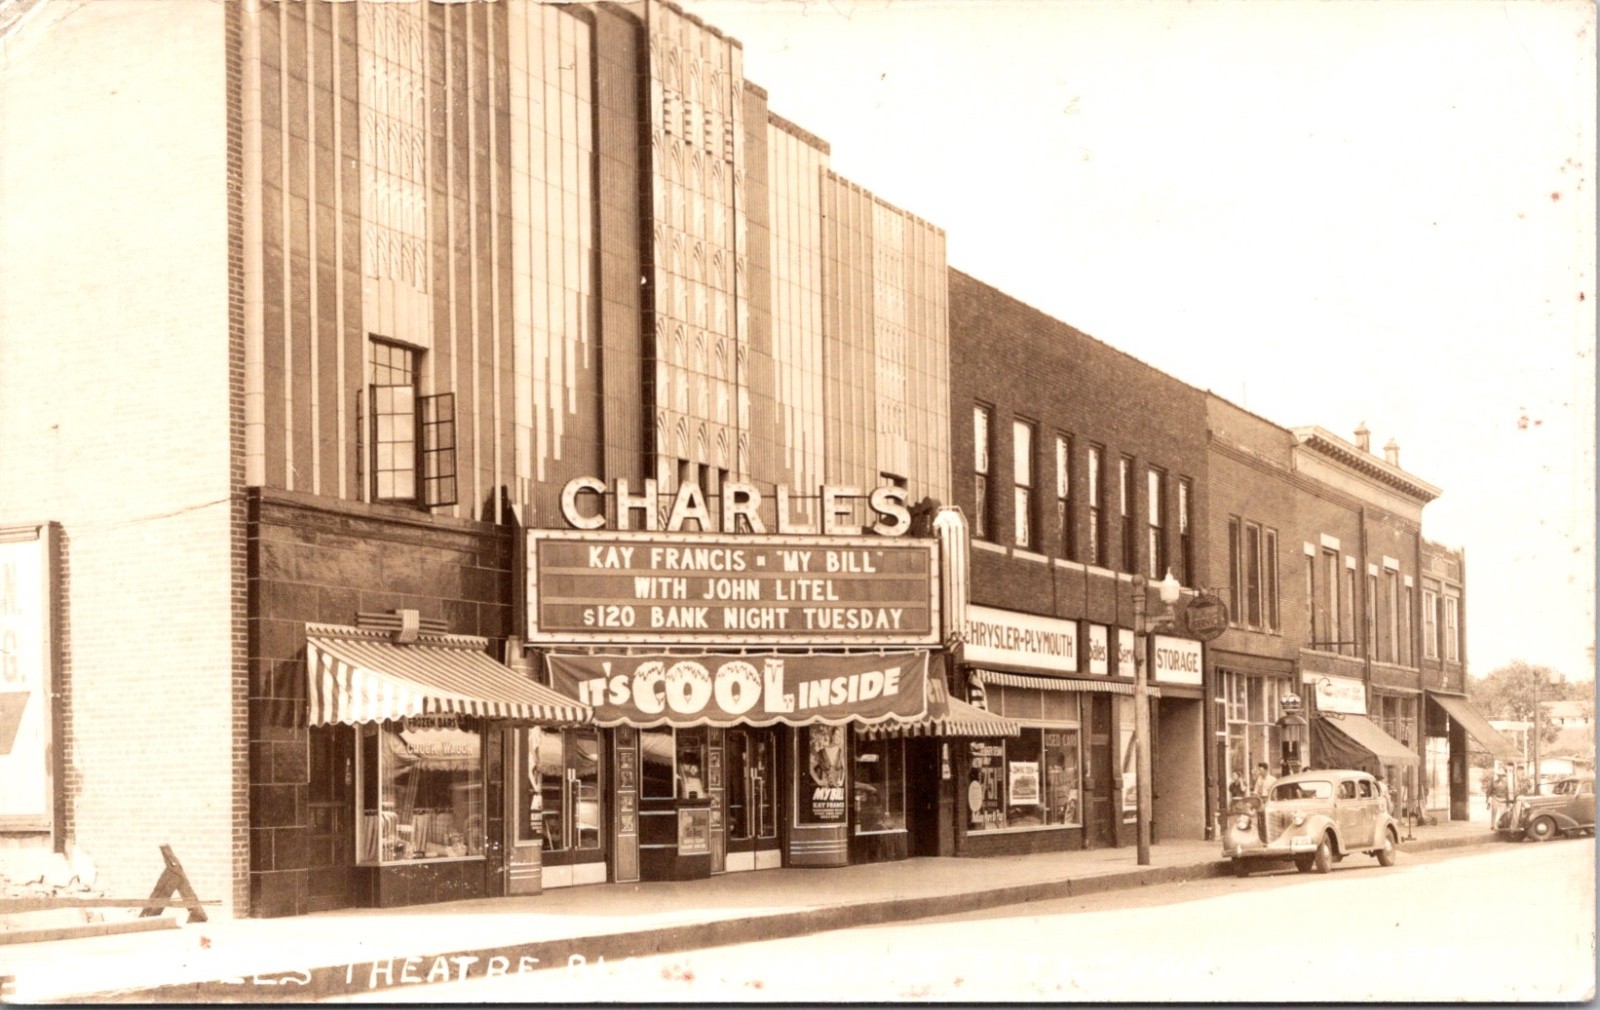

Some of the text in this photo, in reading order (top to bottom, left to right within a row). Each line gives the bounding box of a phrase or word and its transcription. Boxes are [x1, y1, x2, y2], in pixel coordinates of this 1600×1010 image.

[560, 476, 911, 536] CHARLES
[589, 546, 634, 569] KAY
[651, 547, 746, 571] FRANCIS
[634, 577, 839, 601] WITH JOHN LITEL
[583, 605, 903, 629] $120 BANK NIGHT TUESDAY
[1156, 647, 1199, 674] STORAGE
[578, 662, 631, 706] IT'S
[632, 659, 795, 714] COOL
[799, 667, 901, 709] INSIDE
[407, 717, 436, 728] FROZEN
